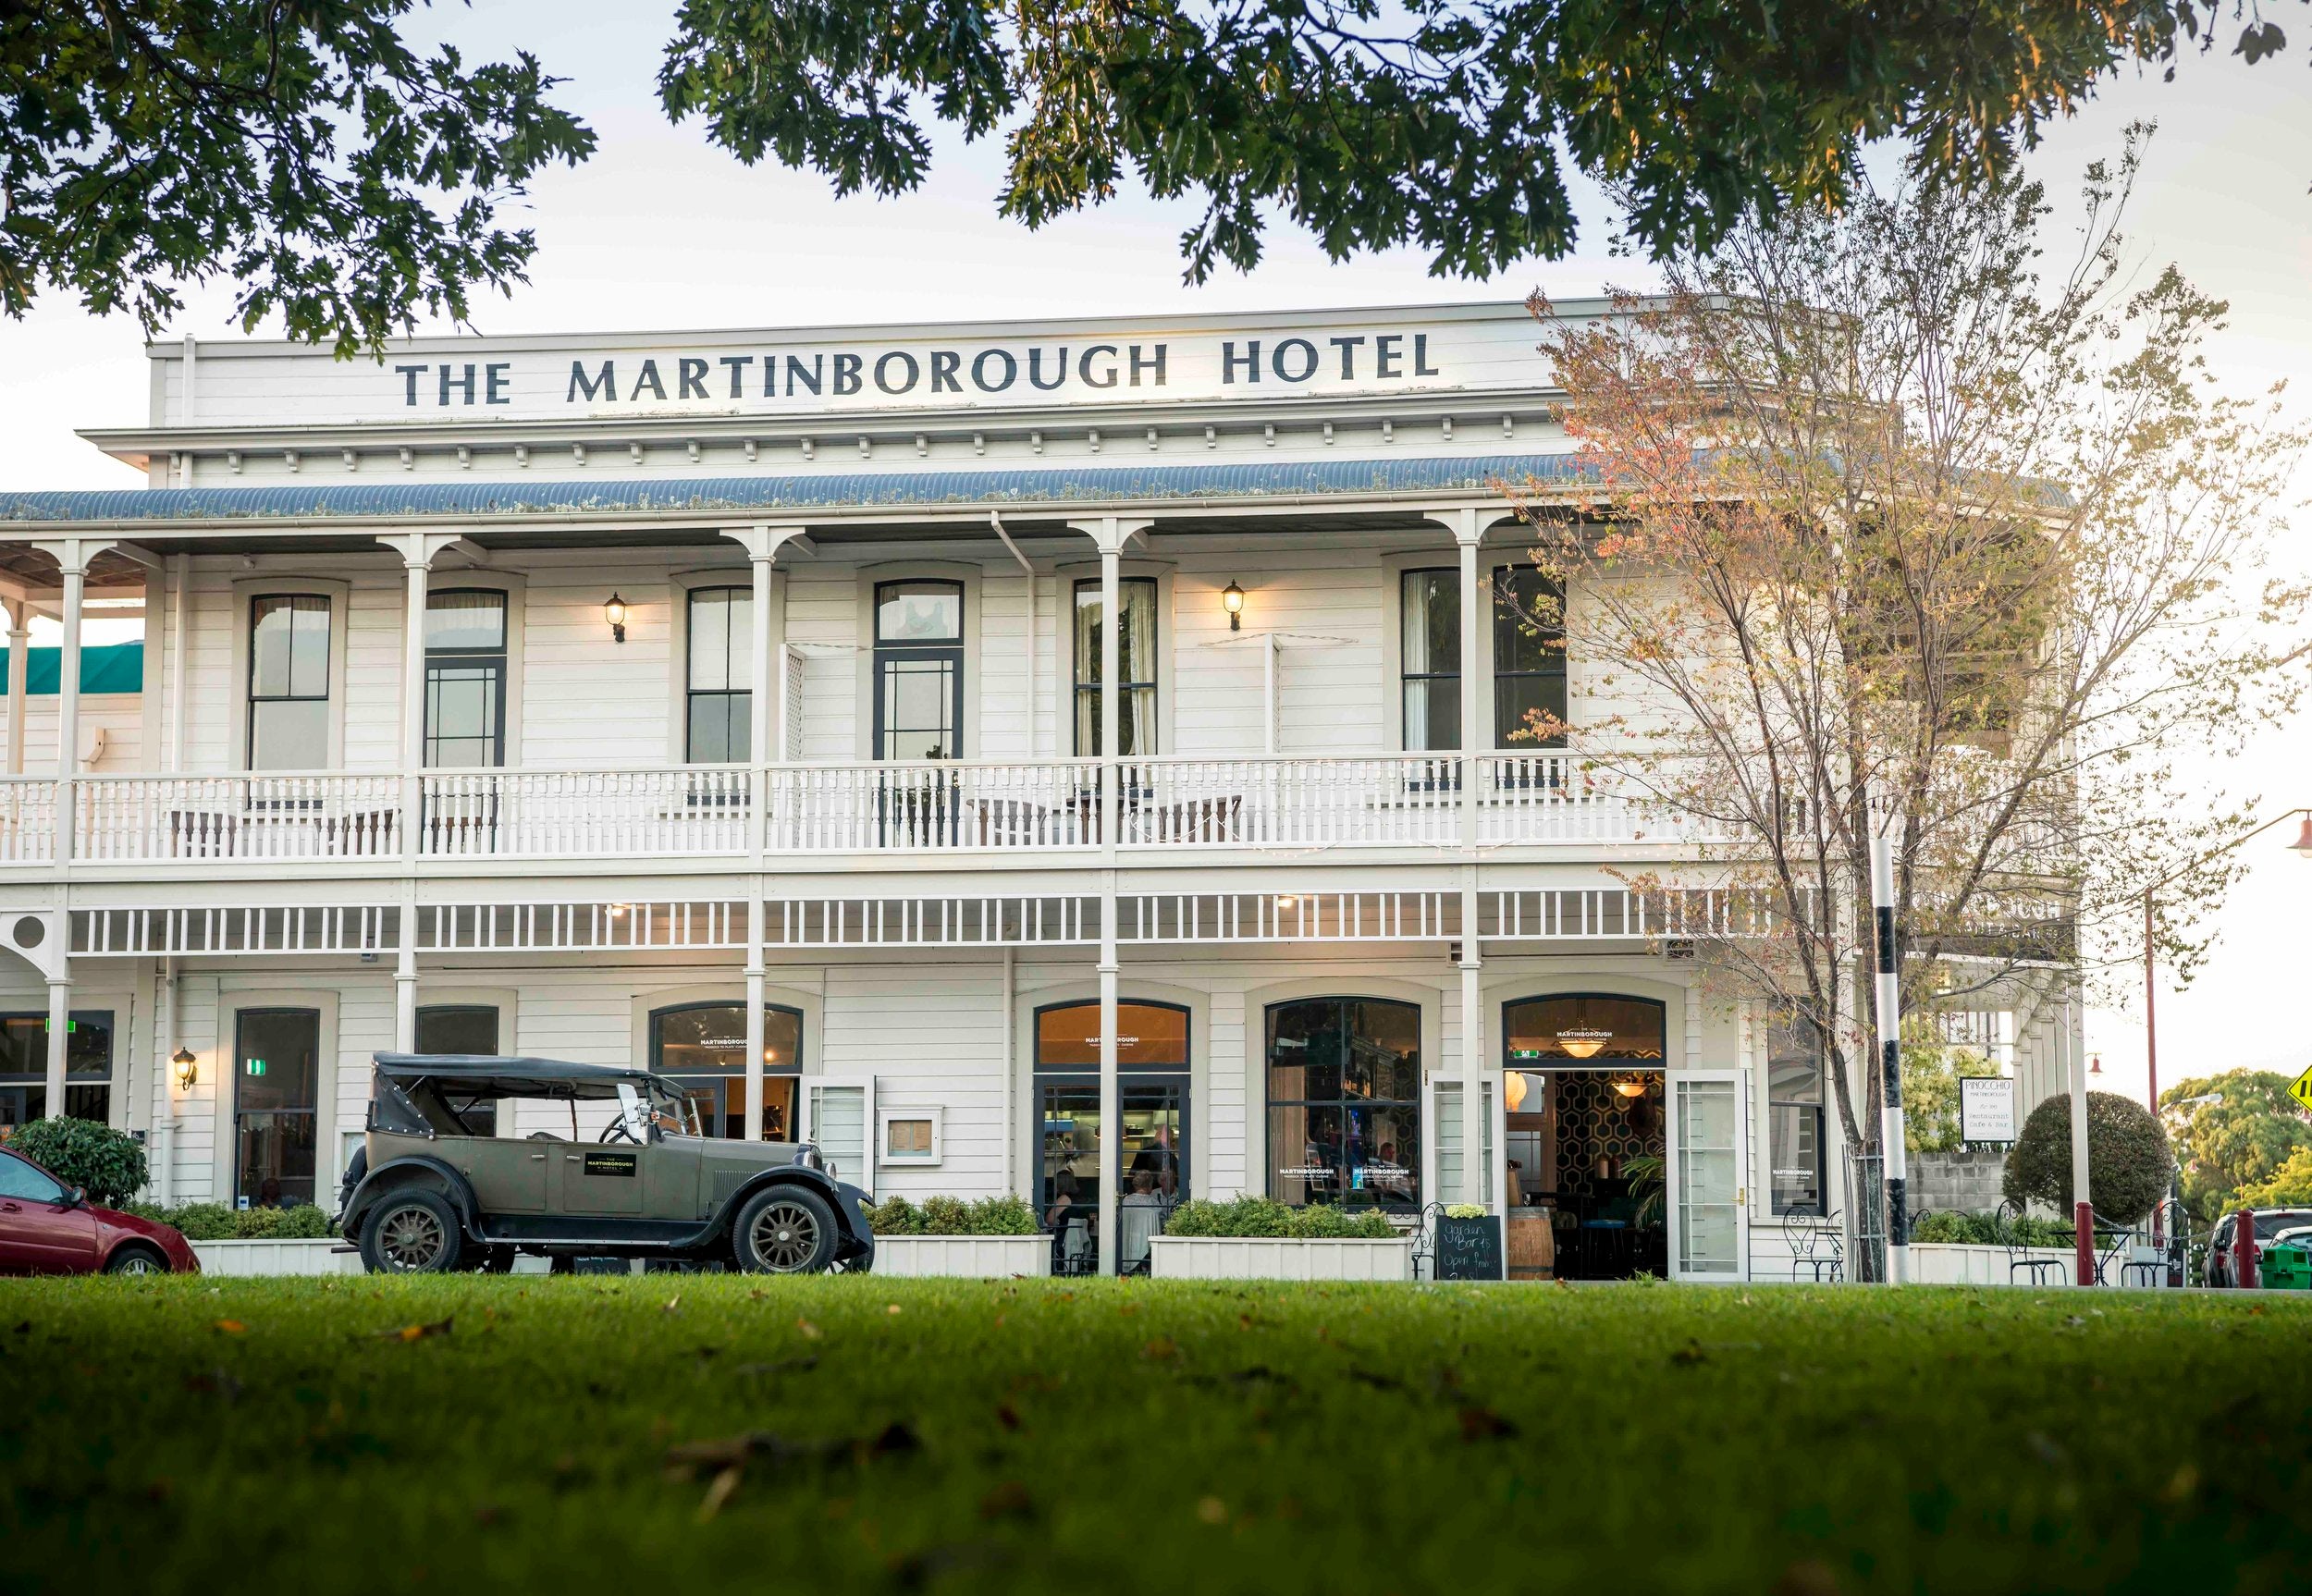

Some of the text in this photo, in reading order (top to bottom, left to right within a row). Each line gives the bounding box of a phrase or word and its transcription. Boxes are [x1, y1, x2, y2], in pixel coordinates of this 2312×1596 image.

[395, 334, 1439, 406] THE MARTINBOROUGH HOTEL
[1965, 1080, 2011, 1090] PINOCCHIO
[1455, 1234, 1479, 1250] Bar
[1444, 1253, 1469, 1270] Open
